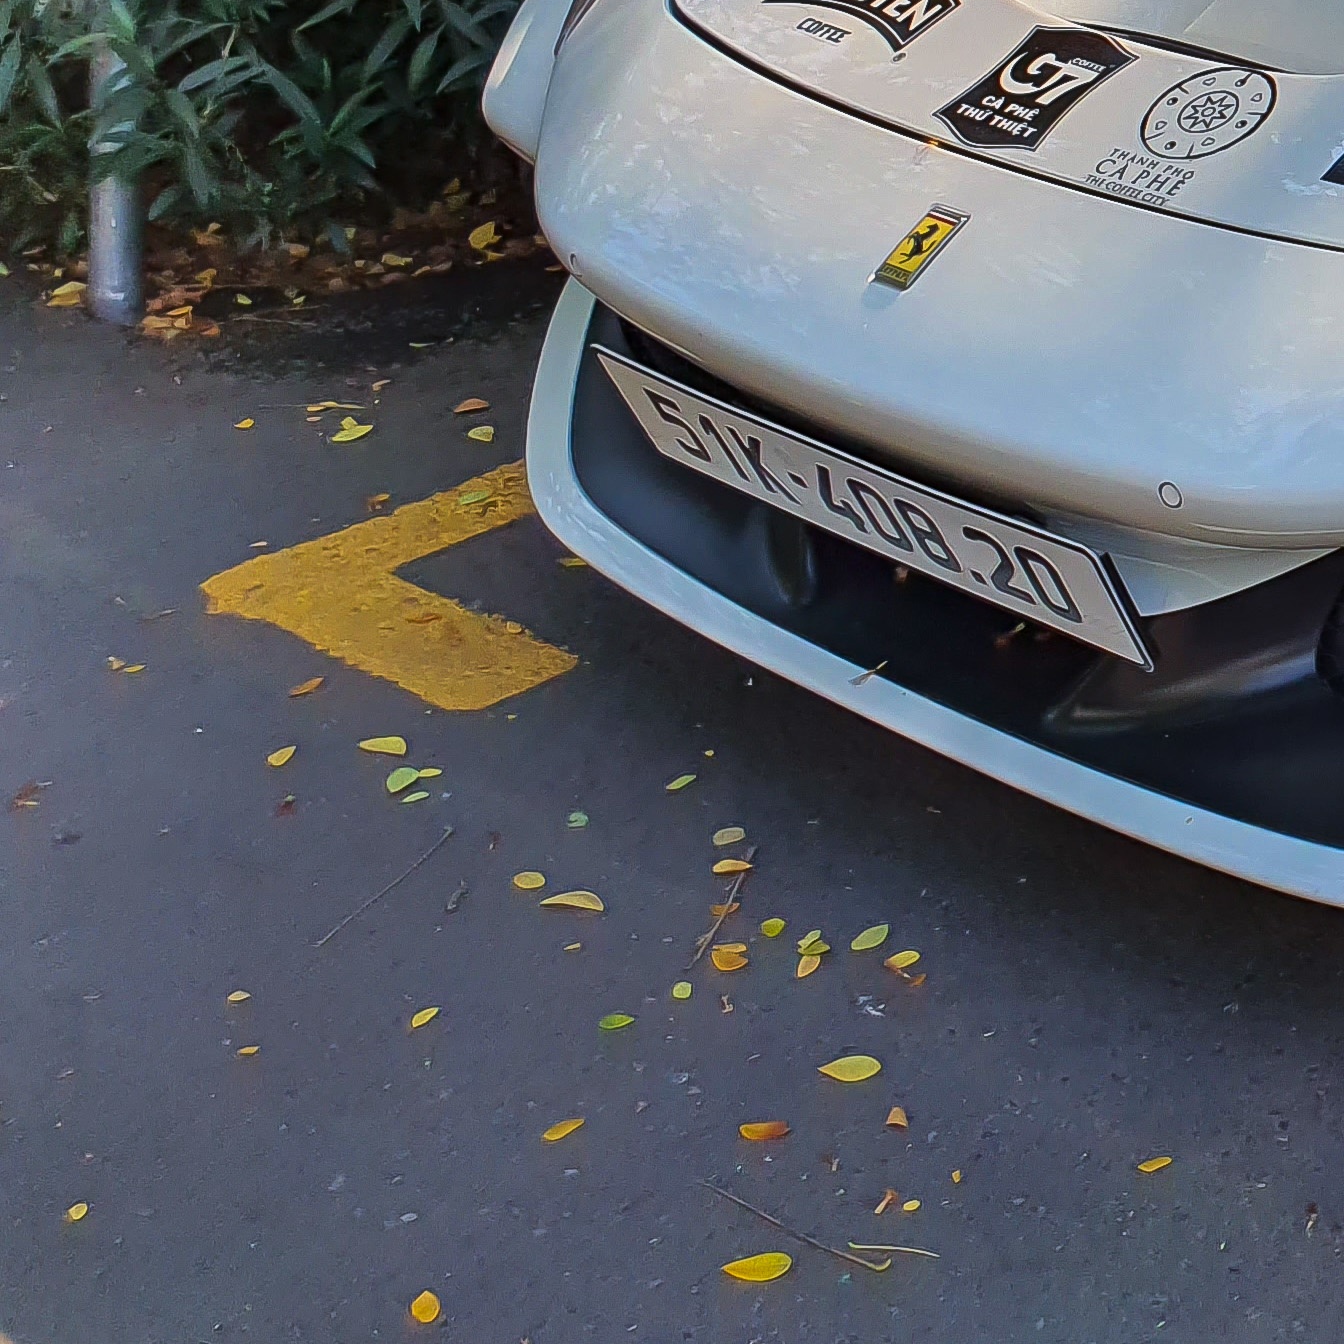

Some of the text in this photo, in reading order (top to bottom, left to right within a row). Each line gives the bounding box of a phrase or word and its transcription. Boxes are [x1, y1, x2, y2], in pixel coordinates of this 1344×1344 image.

[796, 17, 852, 44] COFFEE
[1000, 51, 1100, 106] G7
[982, 94, 1040, 121] CÀ PHÊ
[1130, 169, 1186, 196] PHÊ
[642, 386, 1084, 624] 51K-408.20
